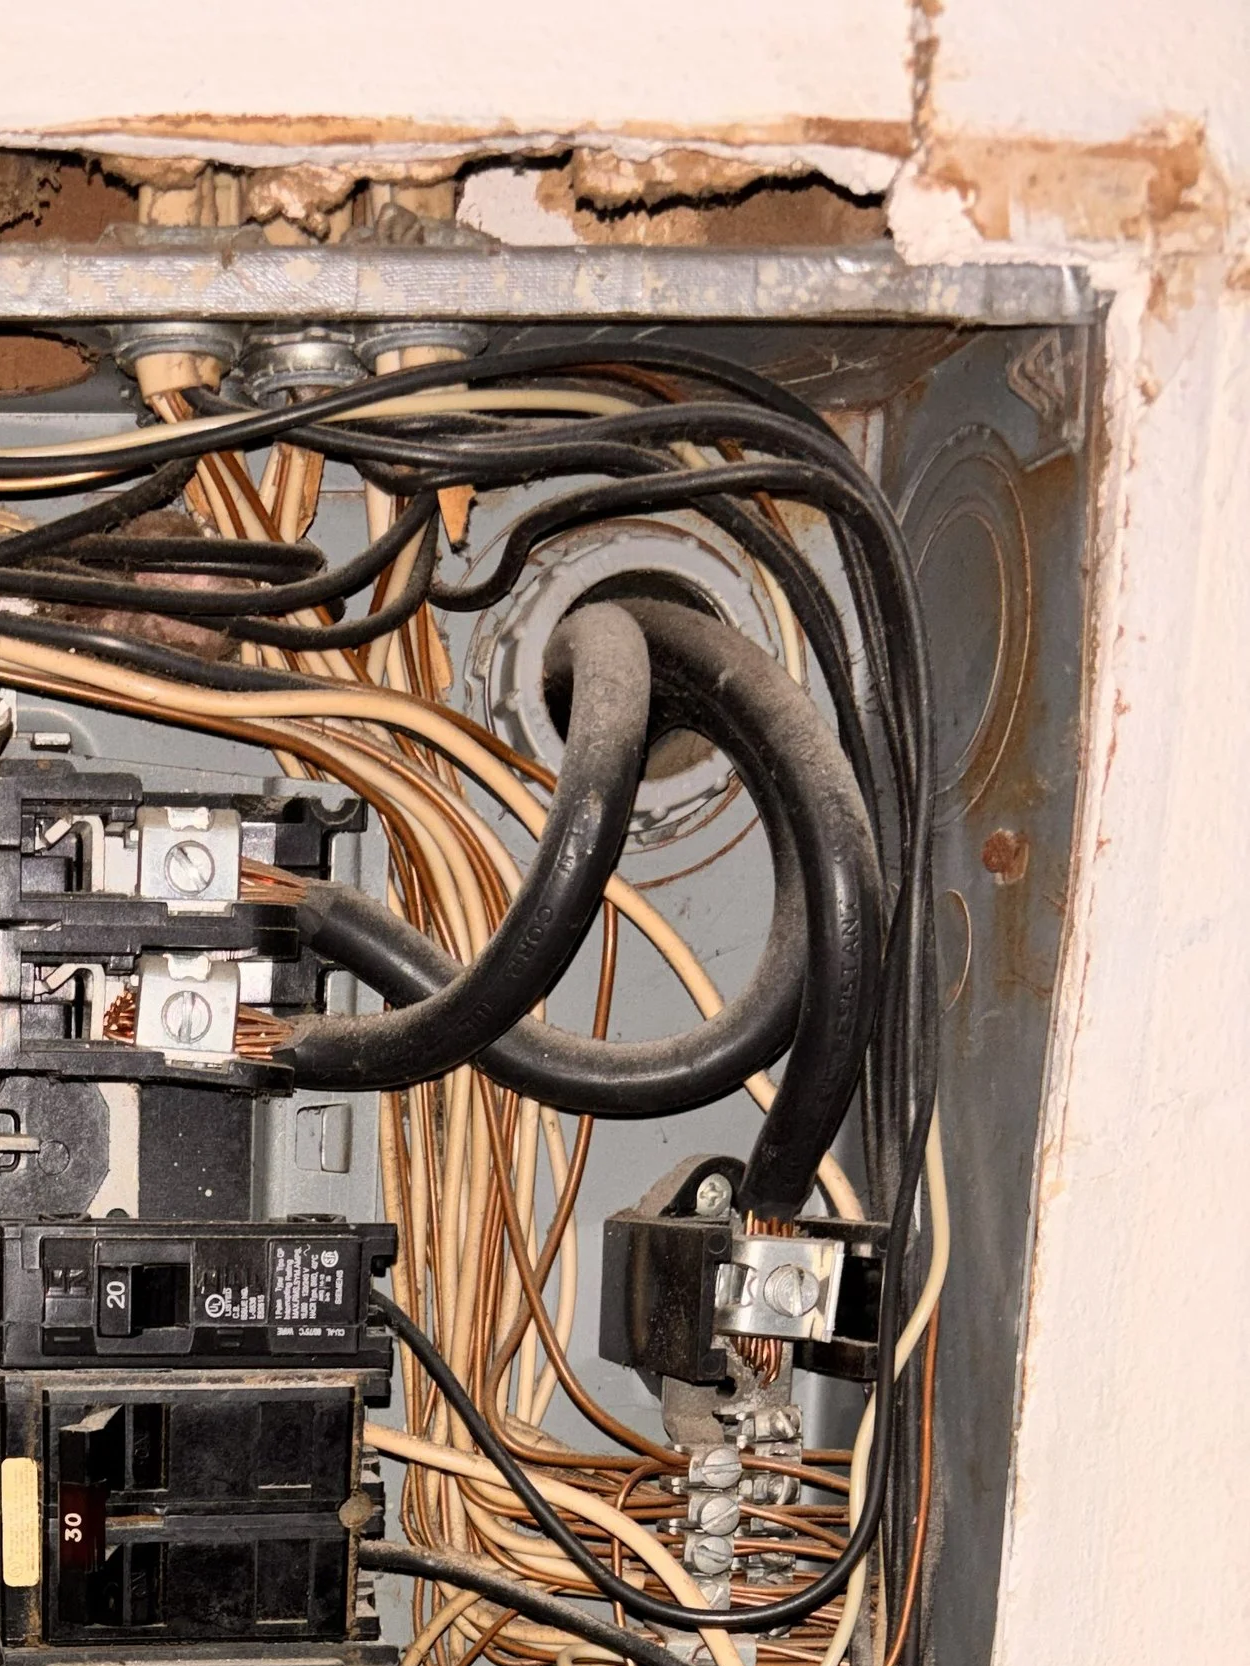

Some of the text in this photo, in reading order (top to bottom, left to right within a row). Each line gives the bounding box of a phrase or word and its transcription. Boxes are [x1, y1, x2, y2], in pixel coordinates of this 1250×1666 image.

[107, 1280, 125, 1309] 20
[335, 1270, 343, 1304] SIEMENS
[65, 1513, 82, 1542] 30
